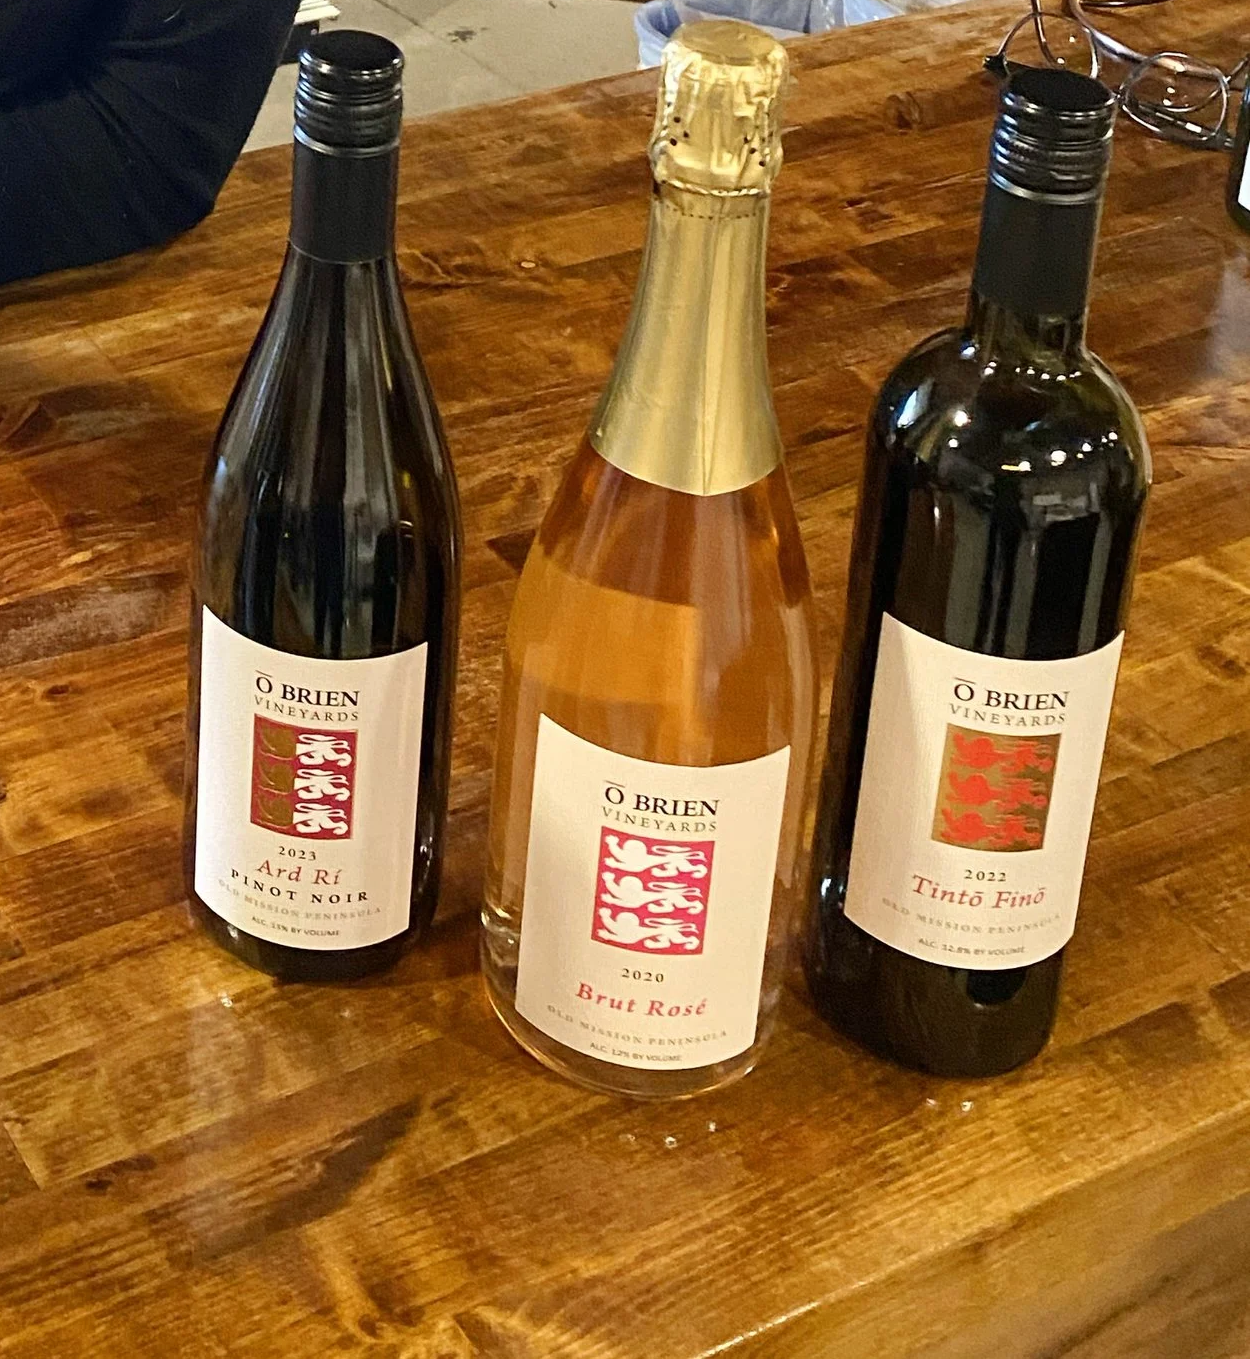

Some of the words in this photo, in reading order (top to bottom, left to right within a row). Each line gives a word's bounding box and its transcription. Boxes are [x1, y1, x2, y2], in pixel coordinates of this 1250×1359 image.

[281, 684, 360, 706] BRIEN
[984, 690, 1070, 711] BRIEN
[253, 694, 359, 722] VINEYARDS
[950, 703, 1066, 727] VINEYARDS
[633, 794, 720, 817] BRIEN
[601, 806, 717, 832] VINEYARDS
[278, 846, 317, 861] 2023
[256, 859, 301, 882] Ard
[313, 869, 342, 885] Rí
[964, 870, 1007, 882] 2022
[231, 869, 296, 900] PINOT
[311, 892, 368, 904] NOIR
[244, 896, 299, 918] MISSION
[305, 907, 381, 920] PENINSULA
[621, 968, 665, 983] 2020
[575, 982, 637, 1013] Brut
[645, 998, 708, 1017] Rosé
[580, 1022, 643, 1044] MISSION
